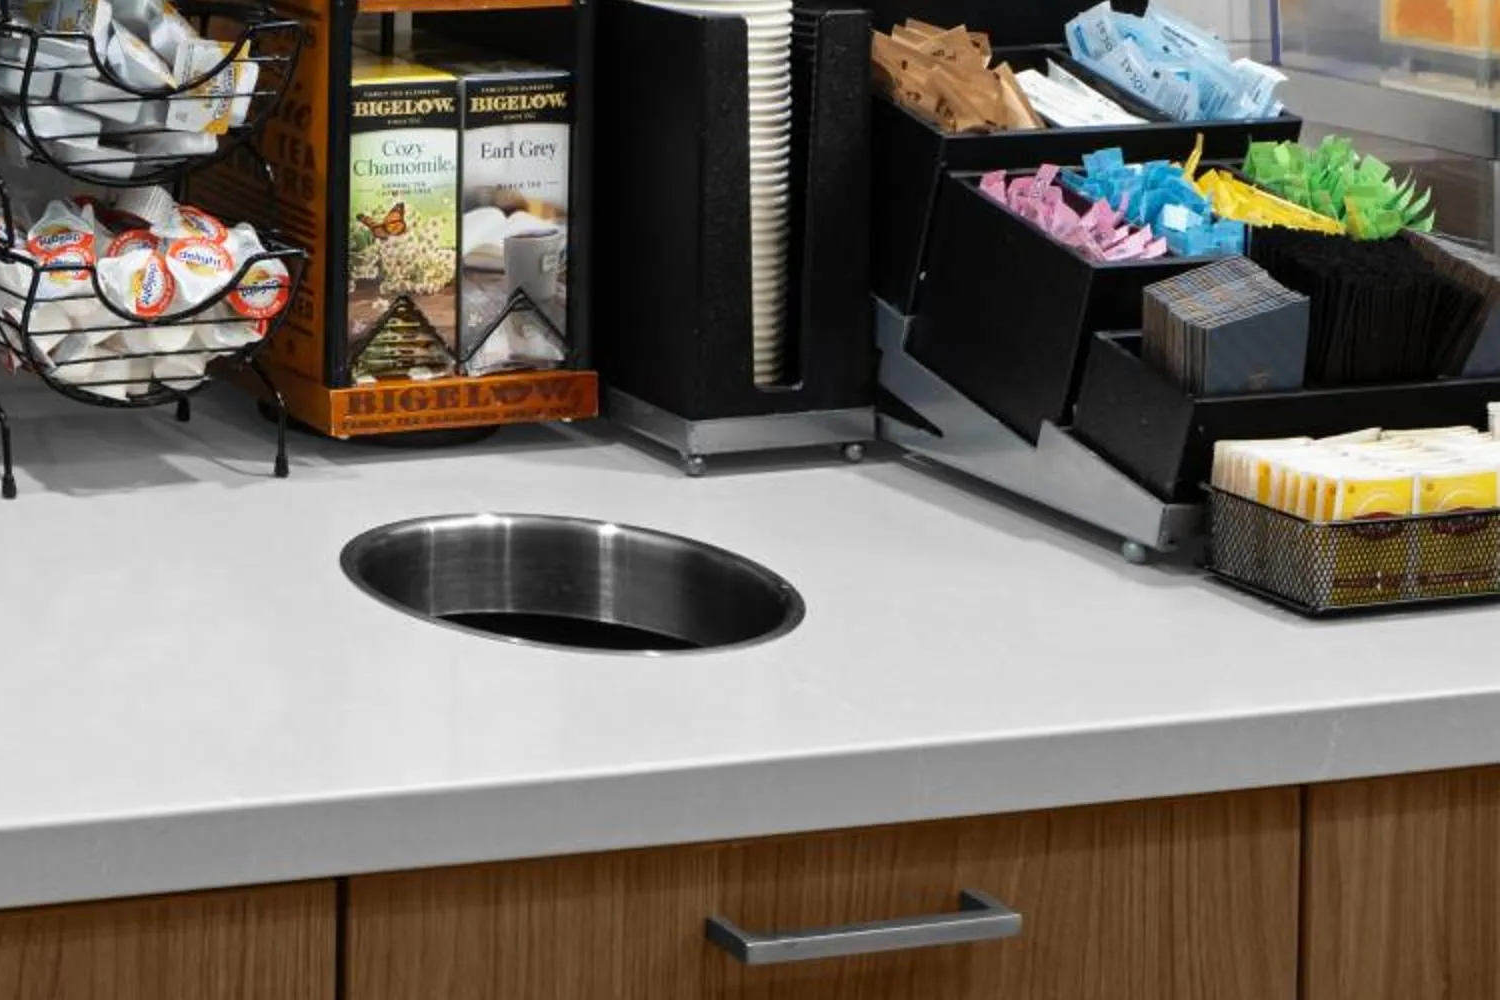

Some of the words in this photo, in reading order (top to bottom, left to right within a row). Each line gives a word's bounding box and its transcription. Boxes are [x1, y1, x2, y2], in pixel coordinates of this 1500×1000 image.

[352, 96, 456, 117] BIGELOW
[469, 91, 568, 113] BIGELOW
[382, 139, 424, 158] Cozy
[481, 141, 515, 160] Earl
[518, 139, 557, 160] Grey
[352, 154, 455, 178] Chamomile
[142, 263, 159, 305] delight
